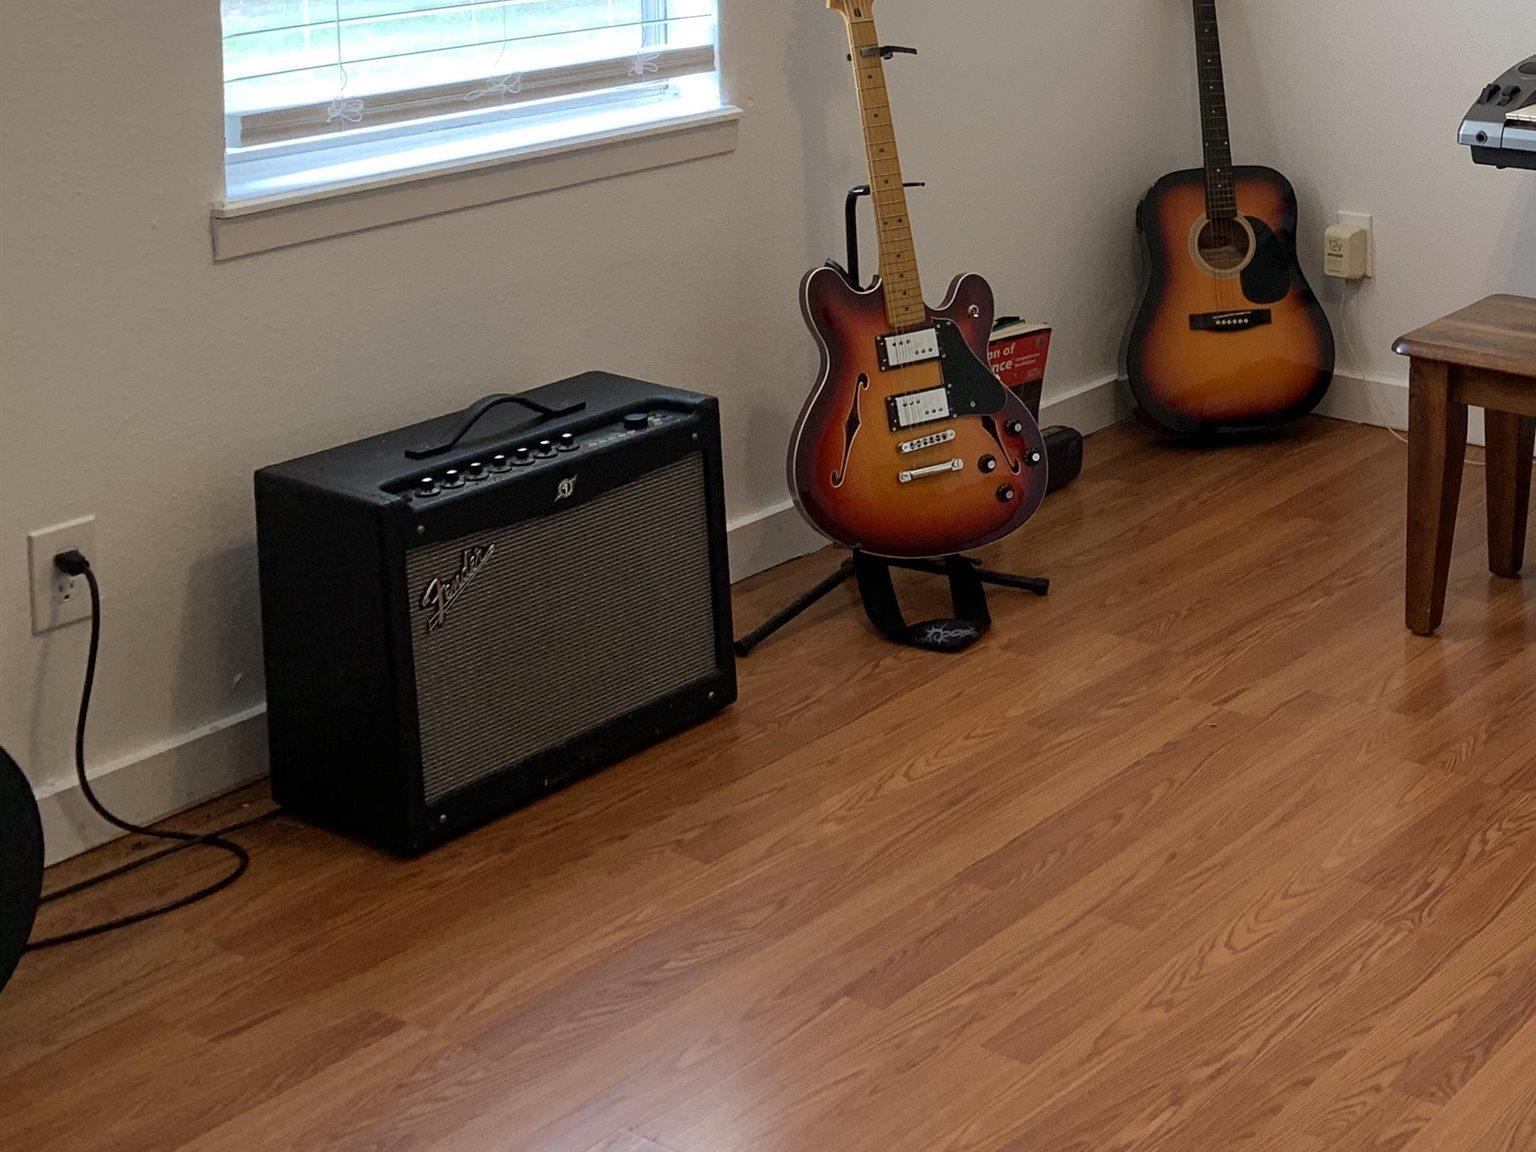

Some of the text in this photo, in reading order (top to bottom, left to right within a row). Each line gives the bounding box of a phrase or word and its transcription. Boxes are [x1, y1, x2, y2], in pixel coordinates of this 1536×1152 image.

[988, 350, 1001, 360] on
[993, 360, 1013, 373] nce
[421, 542, 496, 631] Fender
